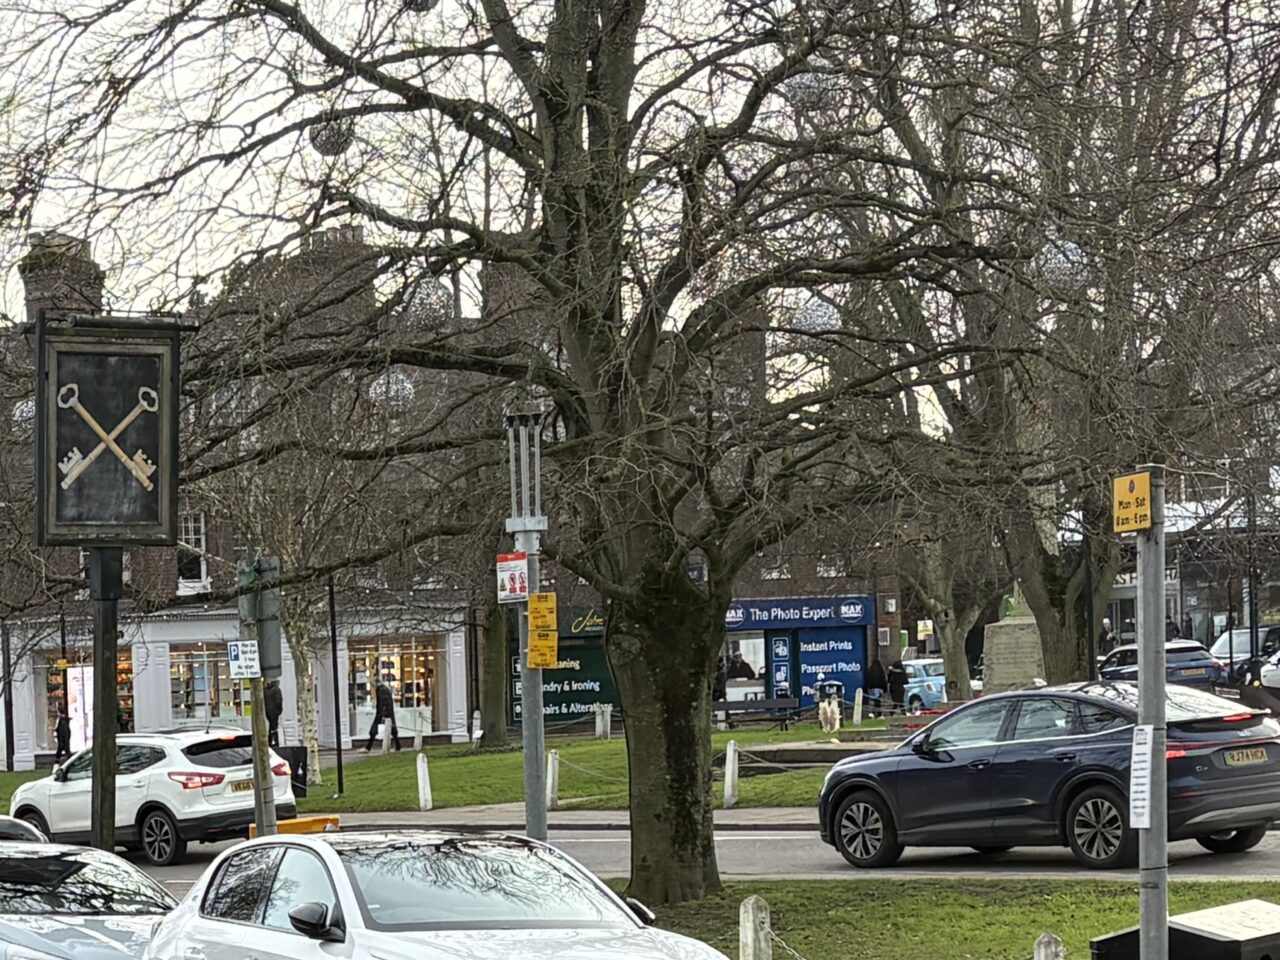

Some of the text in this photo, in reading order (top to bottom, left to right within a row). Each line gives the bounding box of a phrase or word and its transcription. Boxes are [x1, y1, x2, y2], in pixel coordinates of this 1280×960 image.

[1135, 496, 1146, 509] Sat
[750, 608, 768, 621] The
[771, 606, 800, 621] Photo
[802, 605, 835, 622] Expert
[840, 604, 863, 614] MAX
[800, 640, 853, 652] Instant Prints
[231, 646, 238, 660] P
[556, 659, 580, 670] aning
[838, 661, 861, 673] Photo
[542, 679, 600, 694] ndry & Ironing
[542, 704, 559, 717] pairs
[561, 703, 568, 713] &
